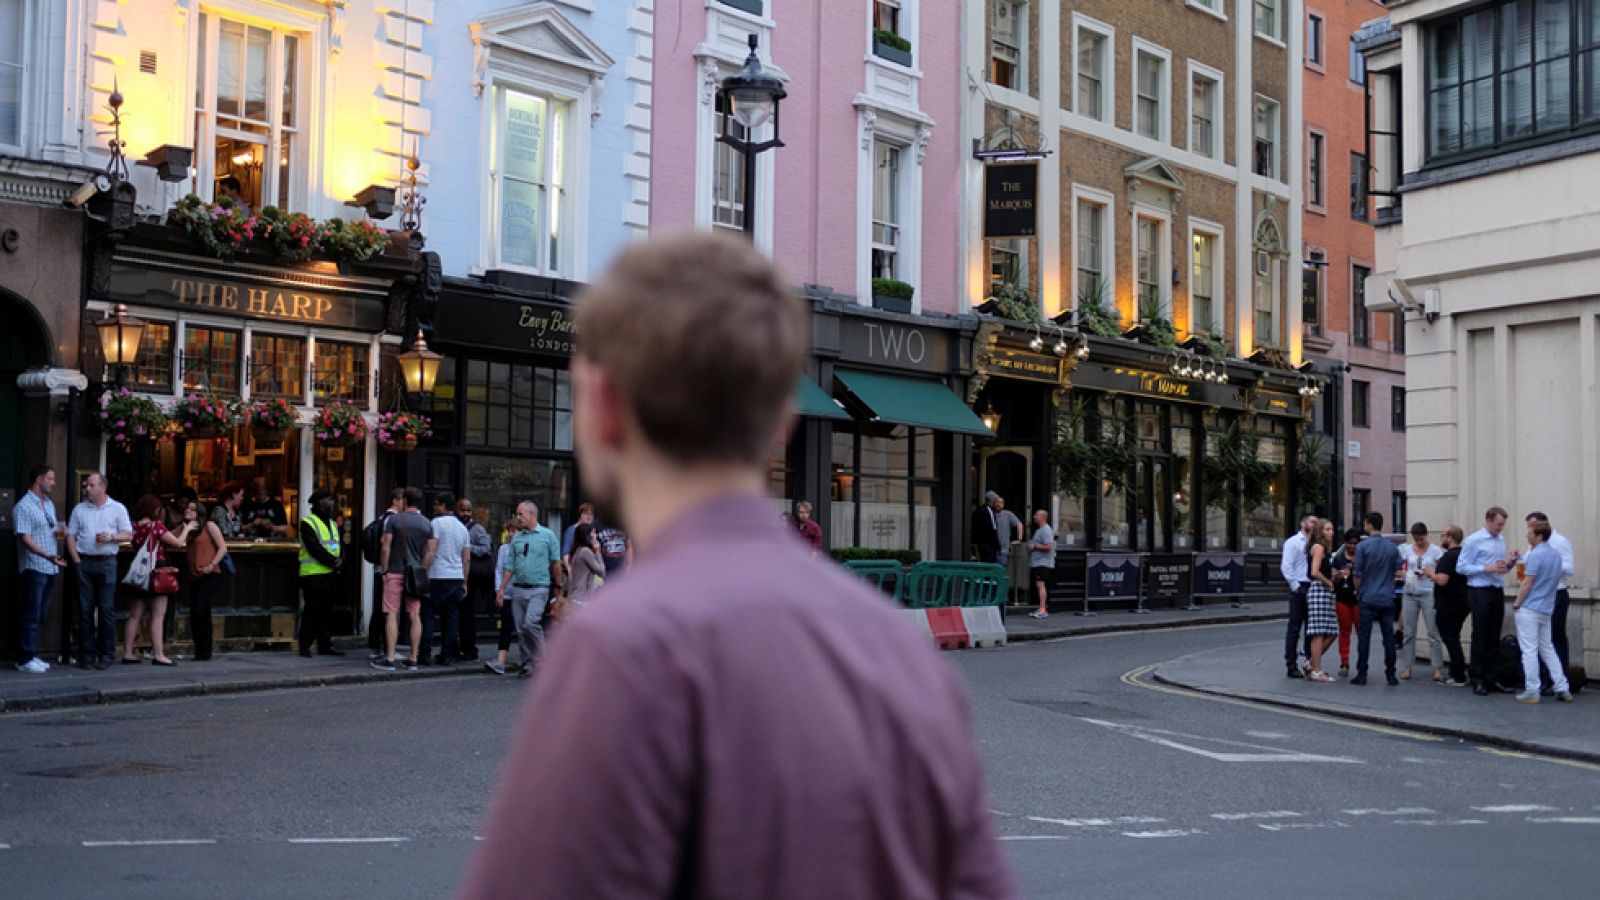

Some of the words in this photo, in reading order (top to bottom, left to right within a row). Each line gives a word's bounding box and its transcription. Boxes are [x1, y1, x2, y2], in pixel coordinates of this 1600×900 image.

[1001, 182, 1022, 192] THE
[990, 199, 1033, 211] MARQUIS
[172, 278, 239, 310] THE
[246, 288, 333, 321] HARP
[518, 305, 549, 337] Envy
[863, 322, 926, 364] TWO
